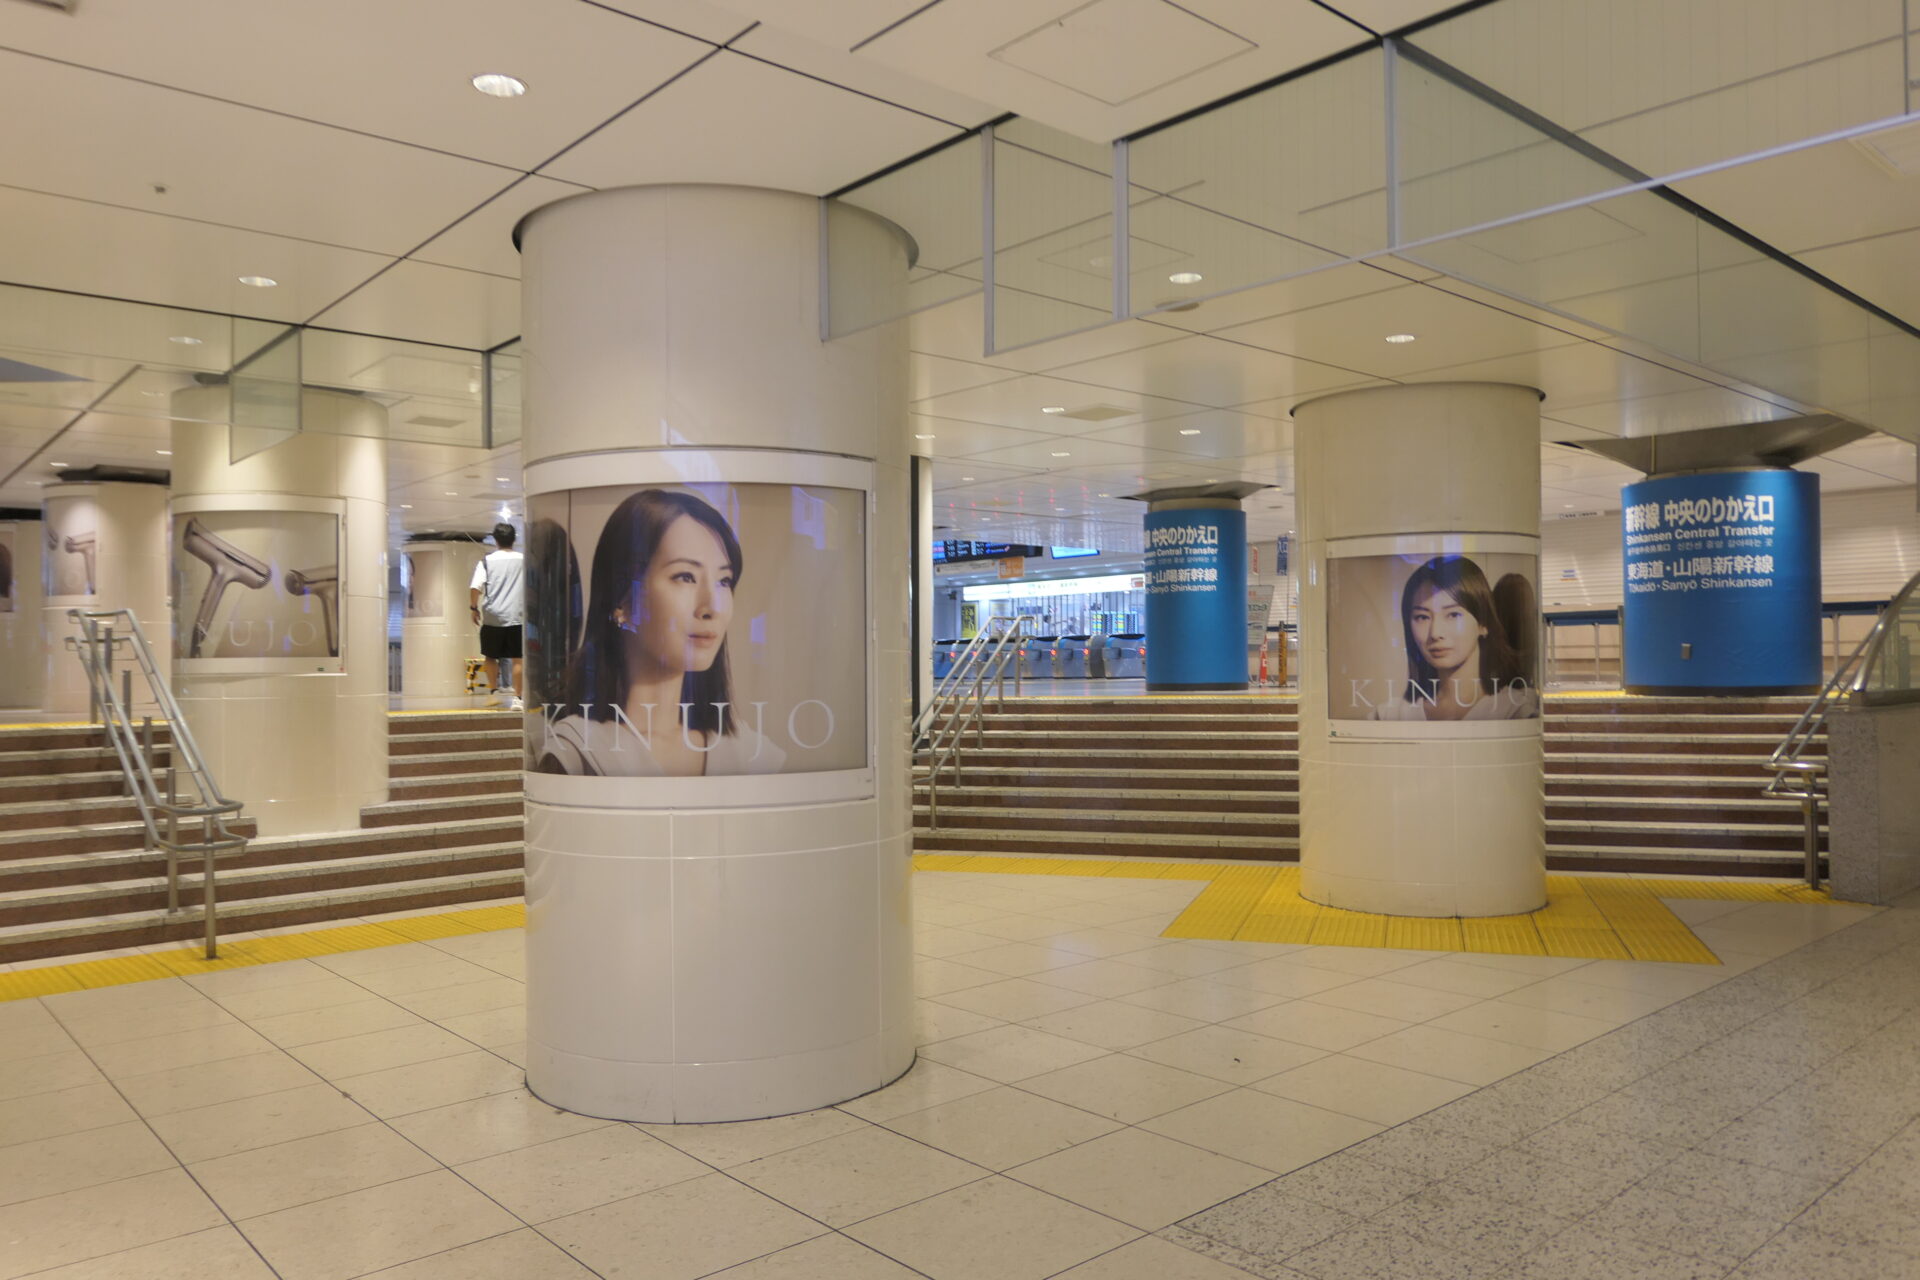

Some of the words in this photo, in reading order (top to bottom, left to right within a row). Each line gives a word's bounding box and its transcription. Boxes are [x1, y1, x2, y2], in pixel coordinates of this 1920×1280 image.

[1625, 502, 1660, 532] 新幹線
[1664, 495, 1775, 527] 中央のりかえ口
[1152, 525, 1218, 548] 中央のりかえ口
[1674, 527, 1719, 540] Central
[1722, 524, 1775, 537] Transfer
[1157, 547, 1182, 556] Central
[1184, 547, 1218, 555] Transfer
[1700, 577, 1773, 589] Shinkansen
[1350, 676, 1528, 712] KINUJO
[541, 699, 835, 762] KINUJO
